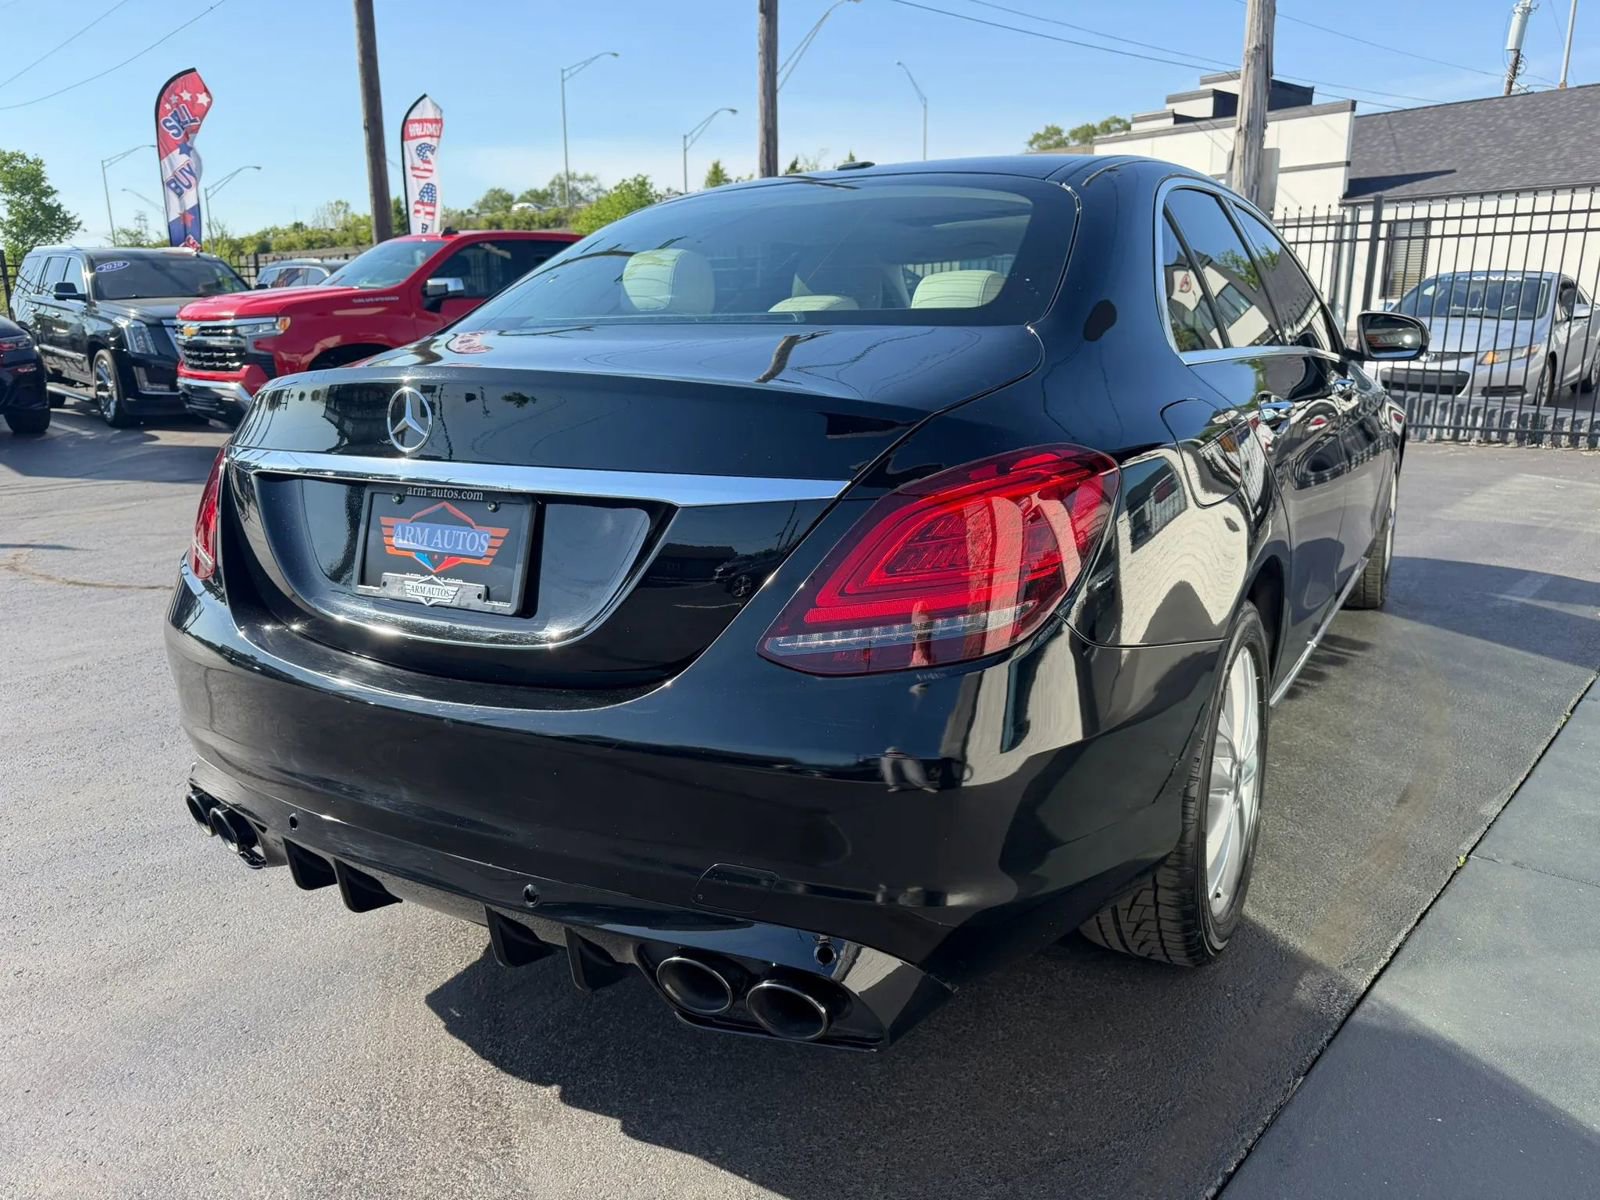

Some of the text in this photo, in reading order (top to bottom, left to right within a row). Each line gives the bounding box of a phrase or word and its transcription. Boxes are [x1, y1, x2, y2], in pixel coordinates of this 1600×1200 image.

[166, 162, 197, 198] BUY
[406, 486, 484, 501] arm-autos.com
[394, 525, 489, 553] ARM AUTOS
[410, 584, 450, 597] ARM AUTOS
